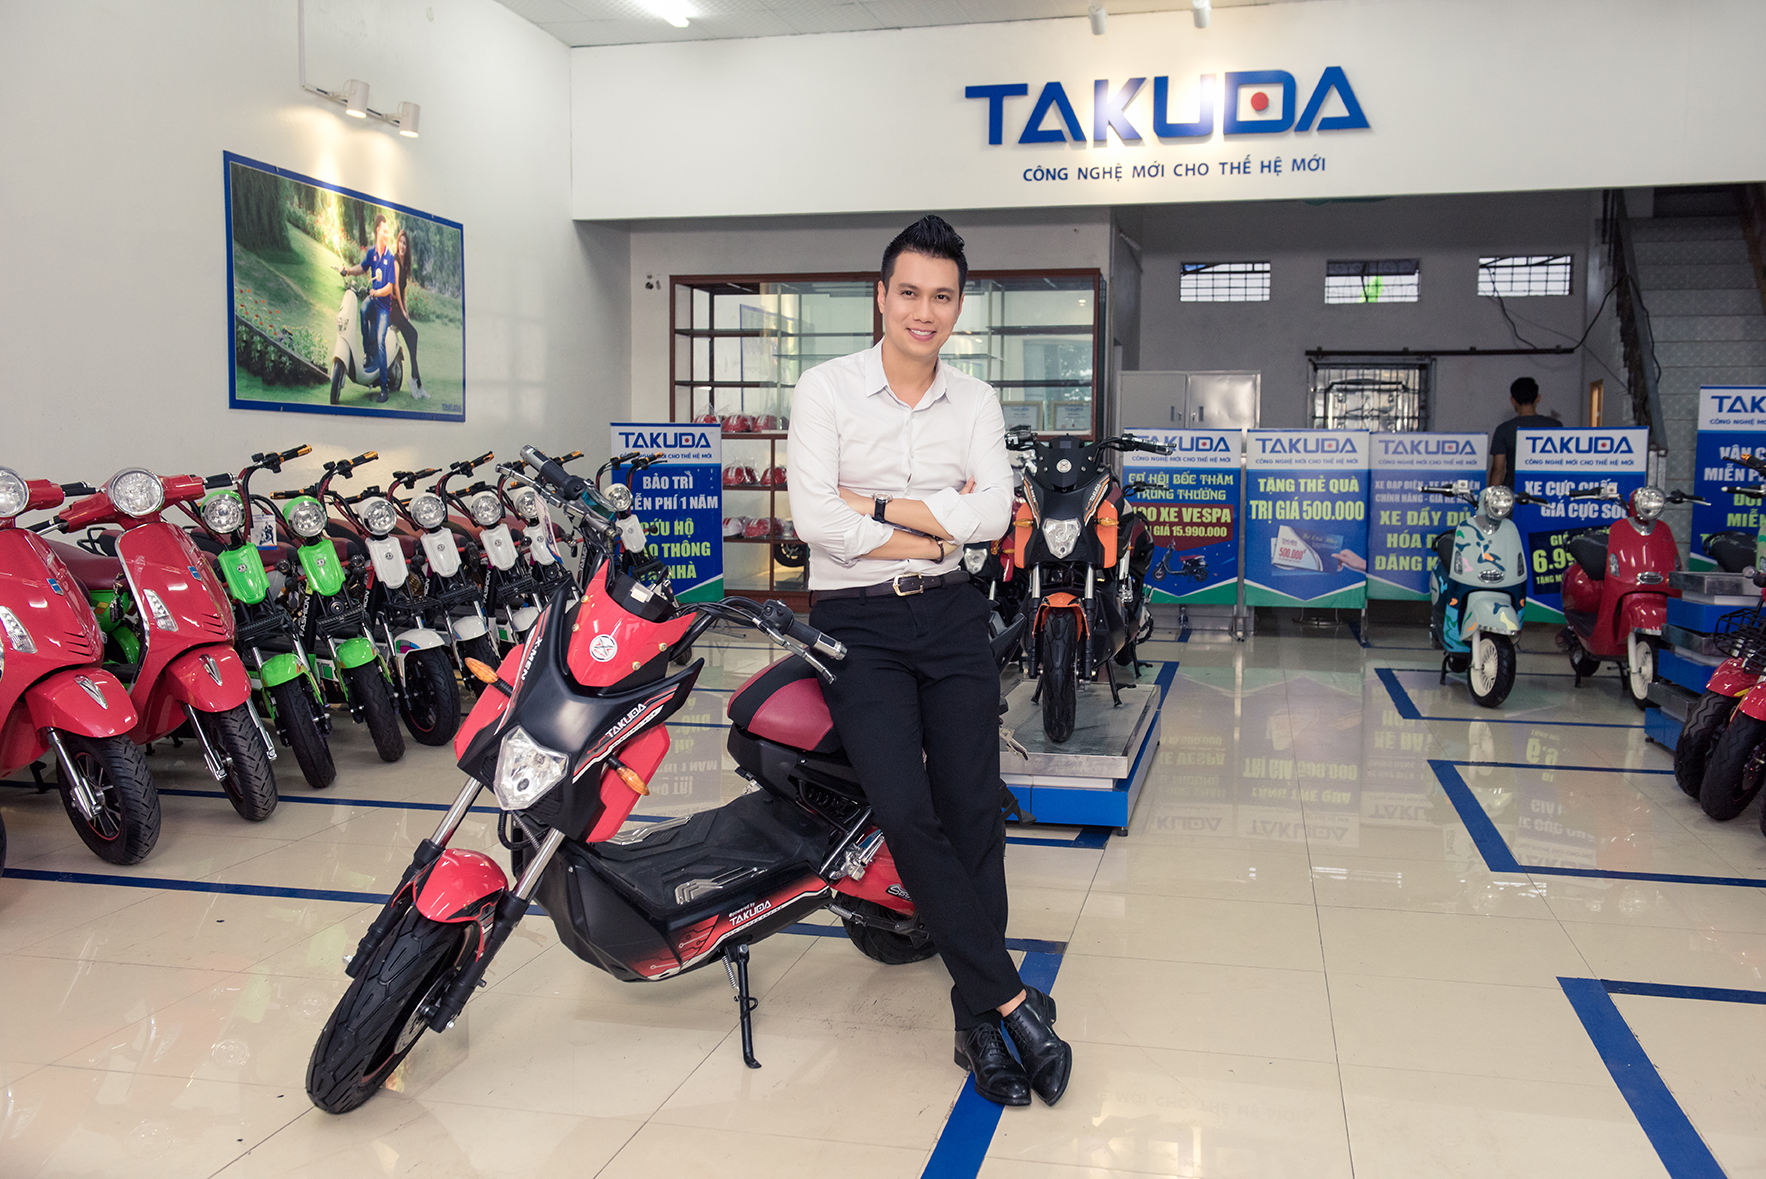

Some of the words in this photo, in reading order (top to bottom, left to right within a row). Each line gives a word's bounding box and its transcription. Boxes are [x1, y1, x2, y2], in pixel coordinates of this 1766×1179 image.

[965, 66, 1370, 145] TAKUDA
[1023, 164, 1069, 182] CÔNG
[1077, 163, 1123, 181] NGHỆ
[1131, 159, 1165, 178] MỚI
[1173, 162, 1209, 177] CHO
[1219, 155, 1251, 175] THẾ
[1260, 156, 1282, 176] HỆ
[1291, 154, 1326, 172] MỚI
[618, 432, 711, 449] TAKUDA
[1255, 438, 1358, 454] TAKUDA
[1378, 440, 1477, 455] TAKUDA
[1525, 436, 1634, 454] TAKUDA
[642, 472, 670, 490] BẢO
[1704, 463, 1746, 481] MIỄN
[1258, 476, 1295, 495] TẶNG
[1298, 475, 1326, 492] THẺ
[1374, 481, 1385, 489] XE
[1524, 480, 1543, 496] XE
[631, 492, 652, 511] ỄN
[655, 494, 678, 510] PHÍ
[680, 496, 687, 510] 1
[690, 494, 718, 510] NĂM
[1249, 500, 1273, 524] TRỊ
[1275, 496, 1300, 520] GIÁ
[1302, 500, 1365, 521] 500.000
[1159, 506, 1179, 522] XE
[1181, 507, 1231, 523] VESPA
[1380, 510, 1402, 526] XE
[1568, 501, 1599, 521] CỰC
[673, 517, 694, 538] HỘ
[1153, 523, 1170, 536] GIÁ
[1171, 525, 1228, 538] 15.990.000
[1386, 529, 1422, 548] HÓA
[661, 540, 711, 558] THÔNG
[667, 561, 697, 579] NHÀ
[1375, 553, 1423, 571] ĐĂNG
[520, 636, 543, 681] X-MEN
[604, 703, 647, 738] TAKUDA
[728, 900, 772, 927] TAKUDA
